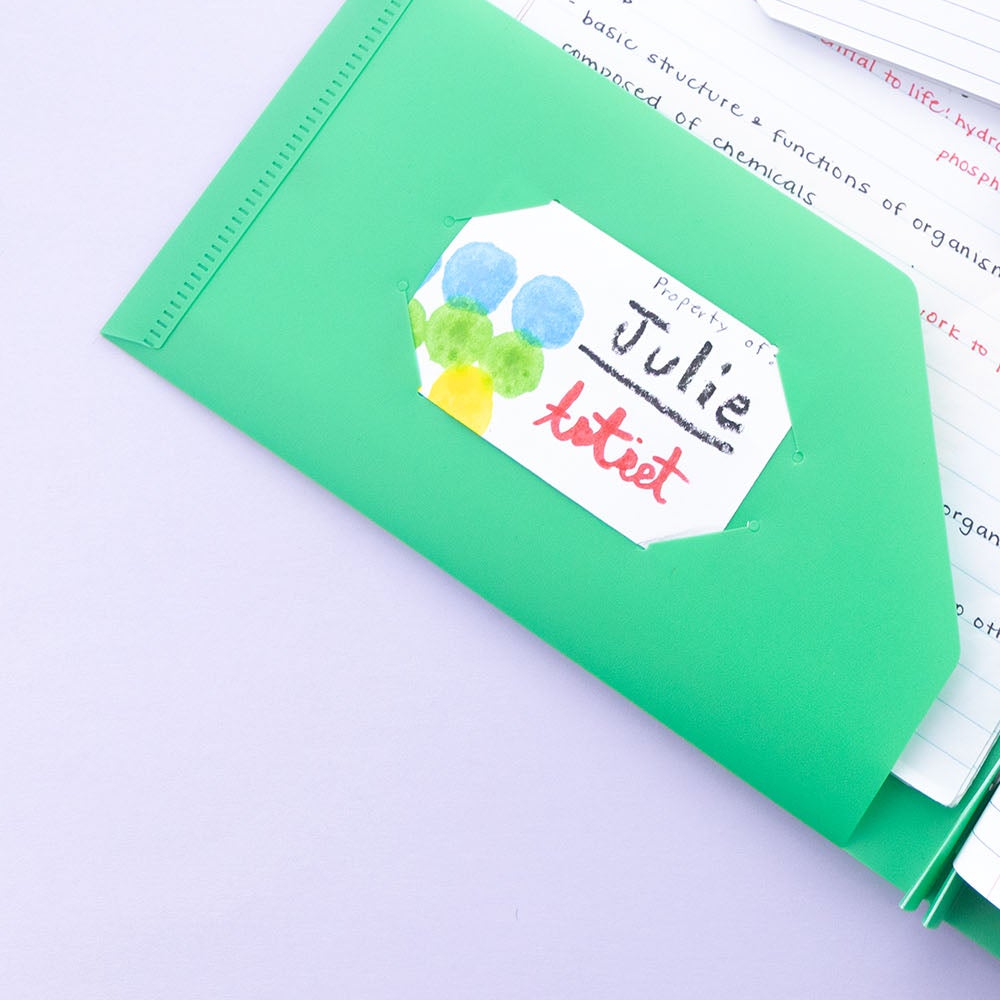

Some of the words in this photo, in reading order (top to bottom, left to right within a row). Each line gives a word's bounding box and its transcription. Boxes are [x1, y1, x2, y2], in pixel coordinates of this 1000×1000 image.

[582, 9, 639, 50] basic
[647, 52, 744, 118] structure
[772, 128, 871, 194] functions
[882, 198, 907, 217] of
[884, 69, 901, 90] to
[675, 111, 702, 131] of
[713, 136, 817, 206] chemicals
[653, 276, 728, 334] Property
[919, 309, 960, 341] ork
[971, 339, 989, 357] to
[611, 299, 752, 435] Julie
